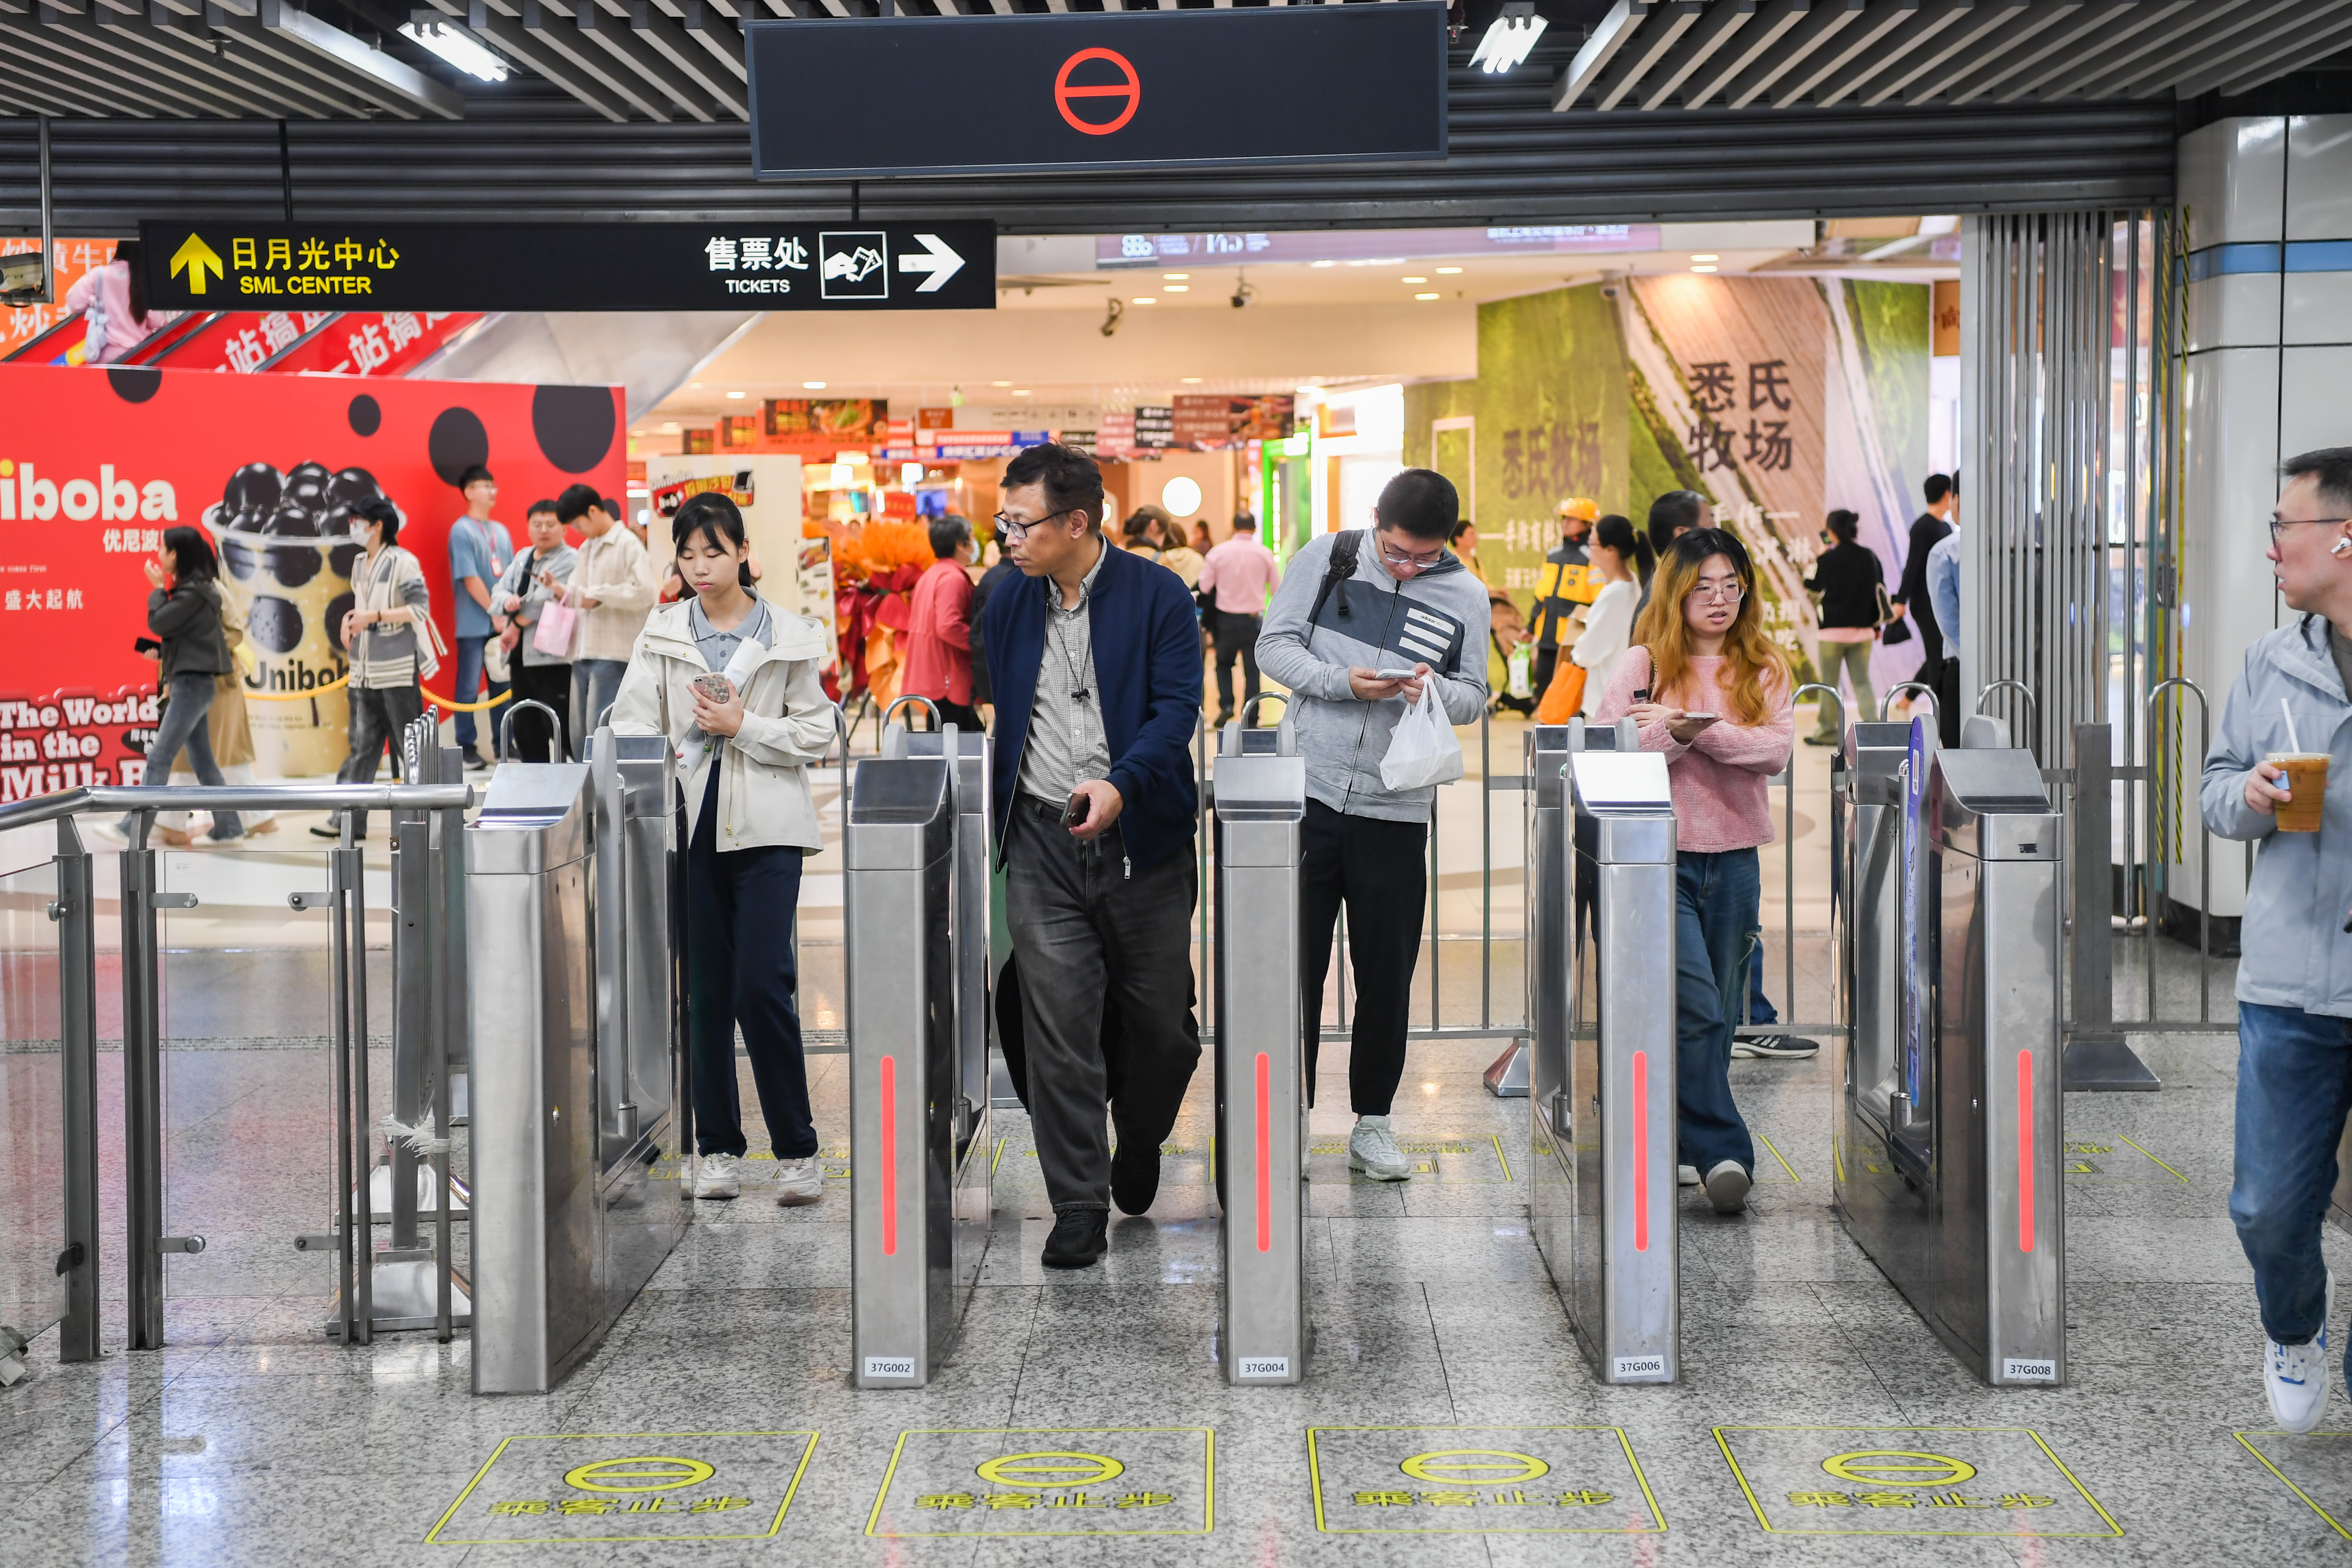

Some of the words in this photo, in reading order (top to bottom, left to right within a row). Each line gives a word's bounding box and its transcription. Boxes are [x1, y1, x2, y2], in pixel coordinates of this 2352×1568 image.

[233, 237, 400, 270] 日月光中心
[705, 236, 809, 271] 售票处
[240, 276, 283, 295] SML
[287, 275, 372, 295] CENTER
[725, 279, 791, 293] TICKETS
[1689, 360, 1791, 413] 悉氏
[1689, 419, 1793, 472] 牧场
[103, 529, 164, 552] 优尼波
[5, 588, 83, 610] 盛大起航
[0, 701, 59, 729] The
[62, 696, 157, 726] World
[1, 733, 37, 761] in
[43, 730, 100, 759] the
[1, 762, 109, 802] Milk
[871, 1362, 910, 1373] 37G002
[1245, 1362, 1285, 1373] 37G004
[1620, 1360, 1660, 1372] 37G006
[2010, 1364, 2051, 1375] 37G008
[487, 1496, 754, 1517] 乘客止步
[914, 1491, 1177, 1511] 乘客止步
[1352, 1489, 1615, 1508] 乘客止步
[1788, 1491, 2058, 1509] 乘客止步
